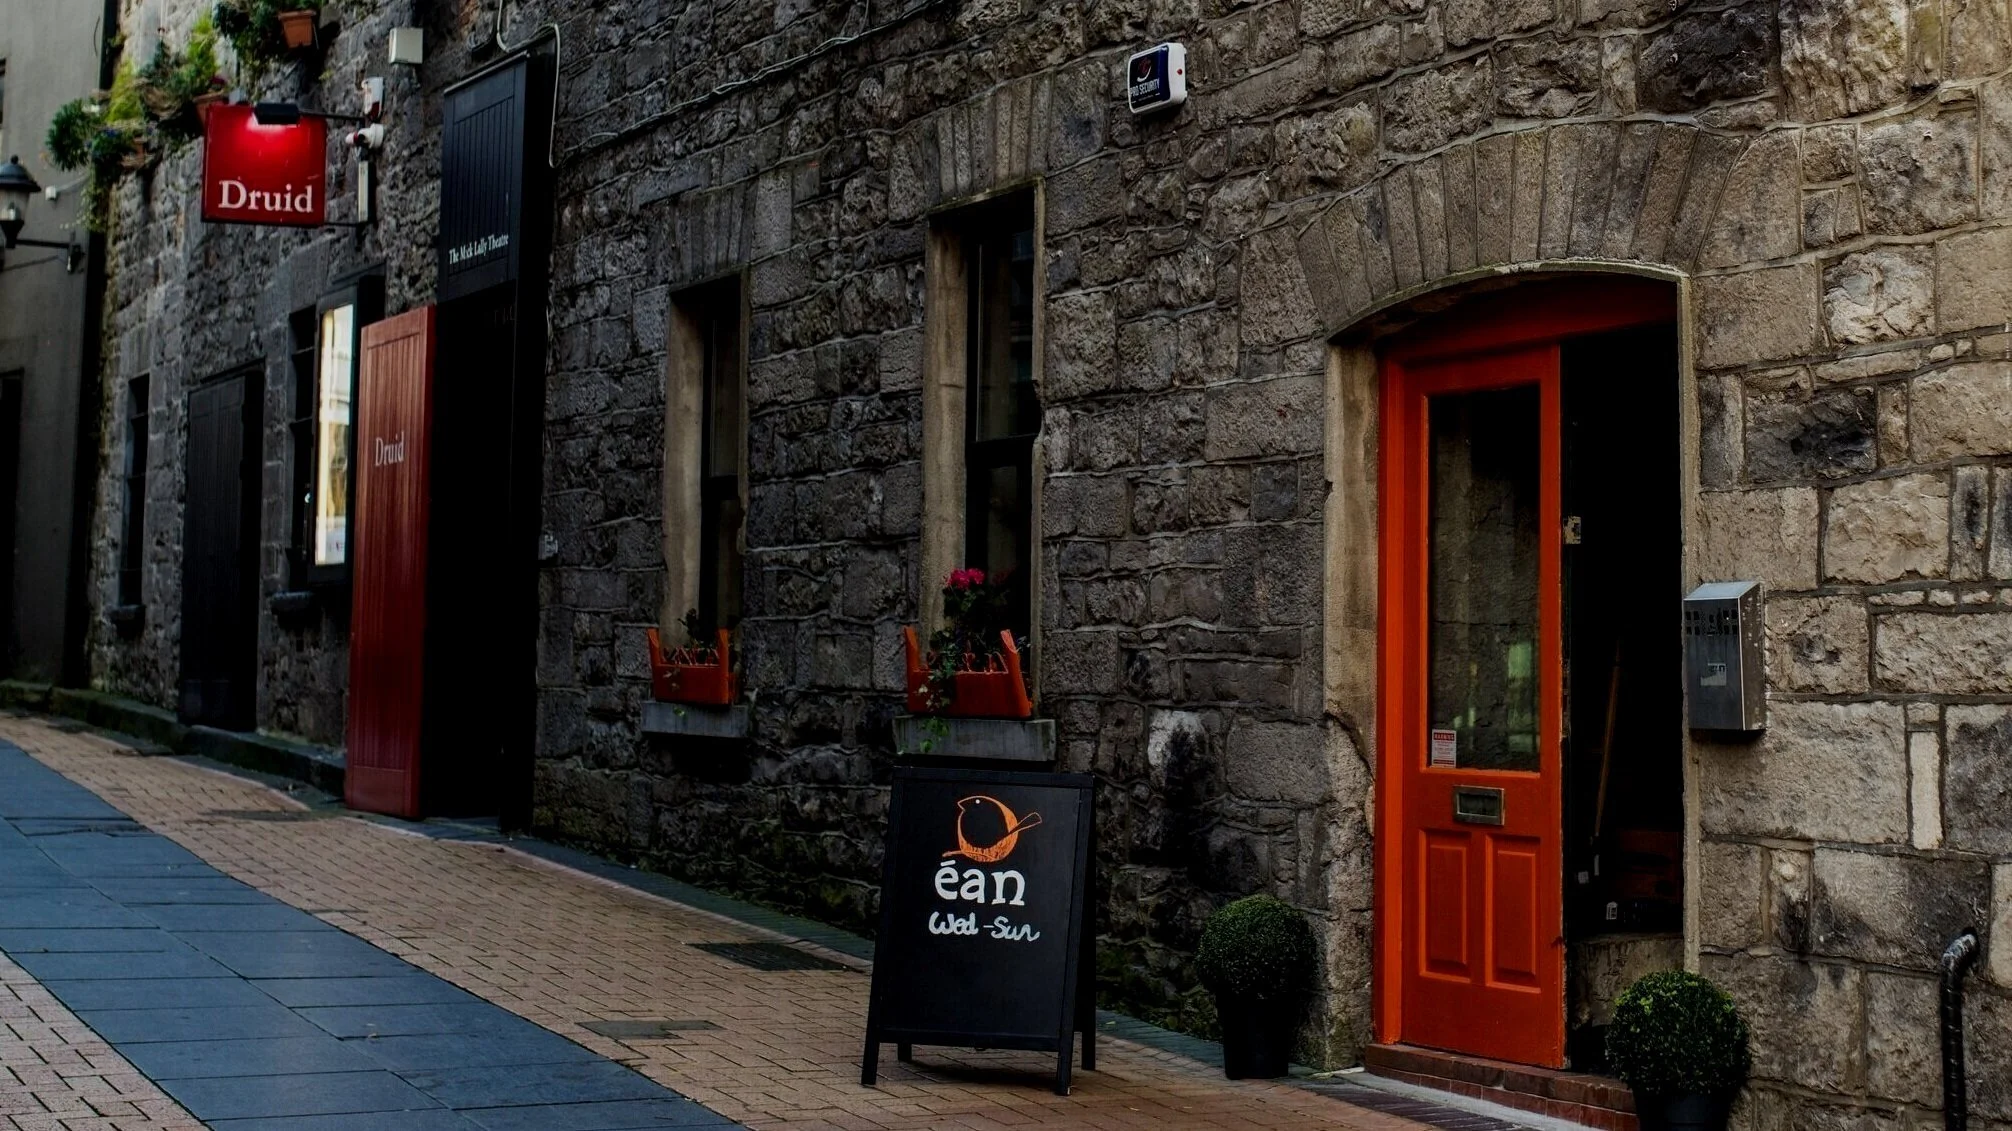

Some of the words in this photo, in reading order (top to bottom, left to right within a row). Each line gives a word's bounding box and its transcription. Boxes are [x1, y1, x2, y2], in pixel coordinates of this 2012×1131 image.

[1139, 77, 1160, 94] SECURITY
[218, 179, 313, 213] Druid
[448, 248, 459, 265] The
[474, 237, 488, 256] Lally
[488, 232, 509, 251] Theatre
[375, 430, 405, 467] Druid
[934, 859, 1026, 906] éan
[928, 910, 979, 936] Wed
